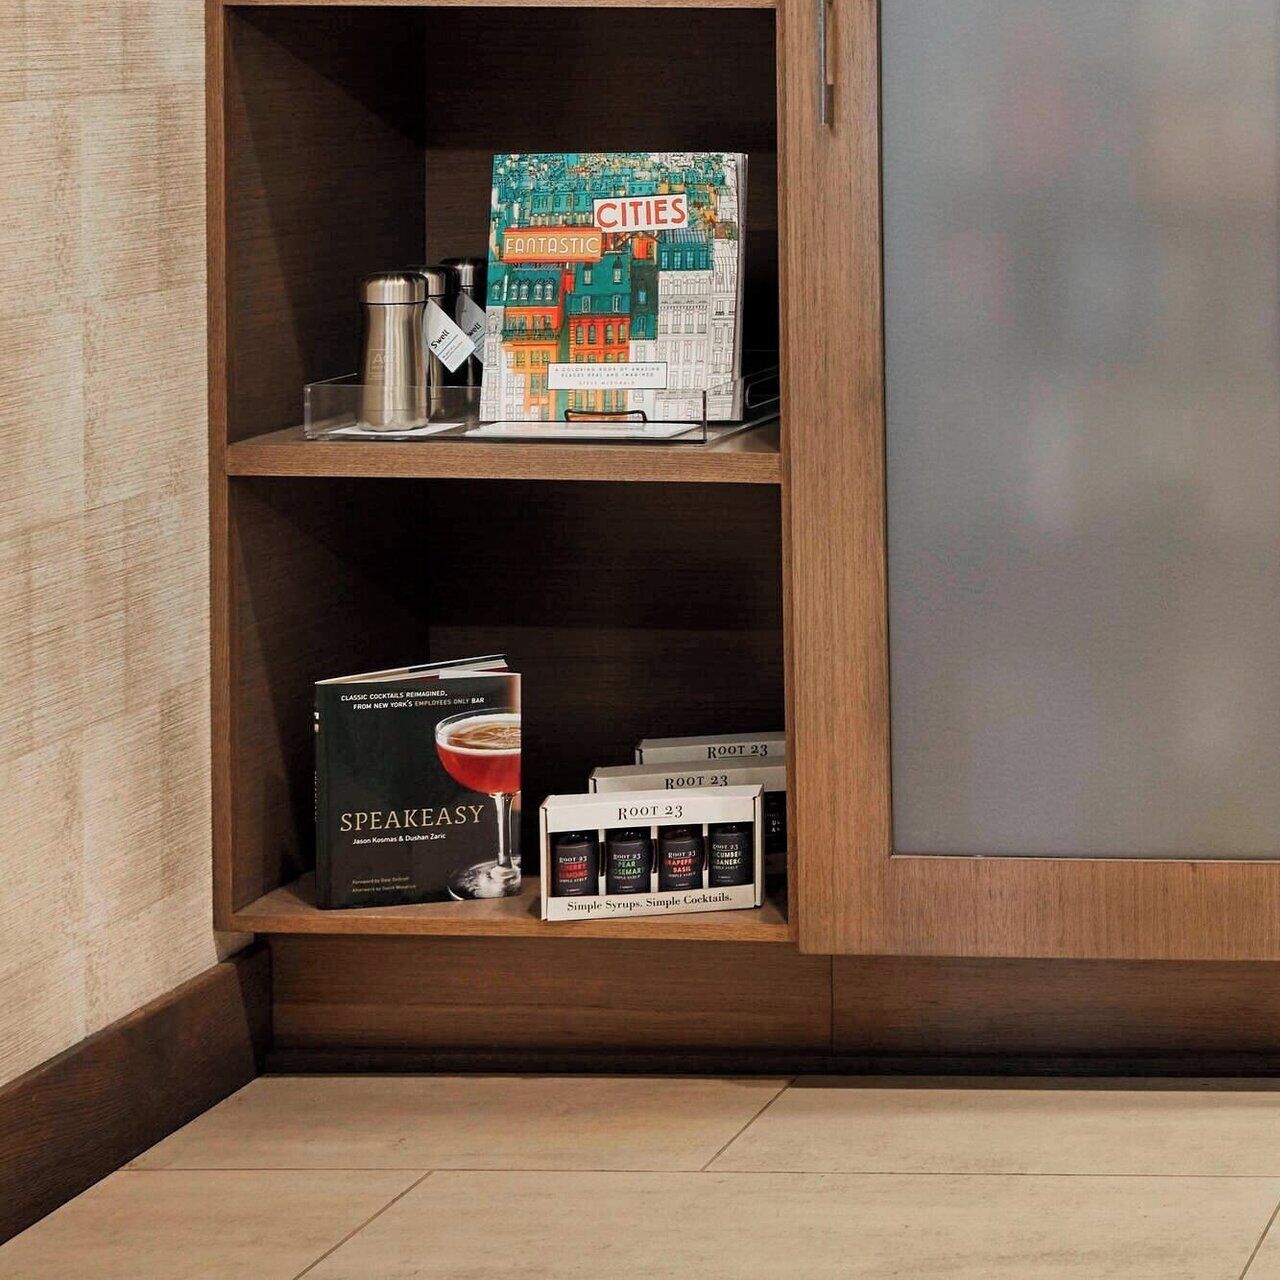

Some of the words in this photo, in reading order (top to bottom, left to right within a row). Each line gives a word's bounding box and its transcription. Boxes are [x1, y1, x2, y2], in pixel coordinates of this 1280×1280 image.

[597, 198, 686, 228] CITIES
[506, 237, 599, 254] FANTASTIC
[390, 700, 413, 708] YORK'S
[708, 746, 745, 759] ROOT
[751, 745, 768, 756] 23
[340, 805, 484, 832] SPEAKEASY
[618, 806, 658, 820] ROOT
[665, 805, 683, 818] 23
[353, 837, 371, 845] Jason
[430, 832, 446, 840] Zaric
[567, 901, 602, 911] Simple
[605, 899, 642, 913] Syrups.
[646, 898, 681, 908] Simple
[683, 892, 732, 905] Cocktails.
